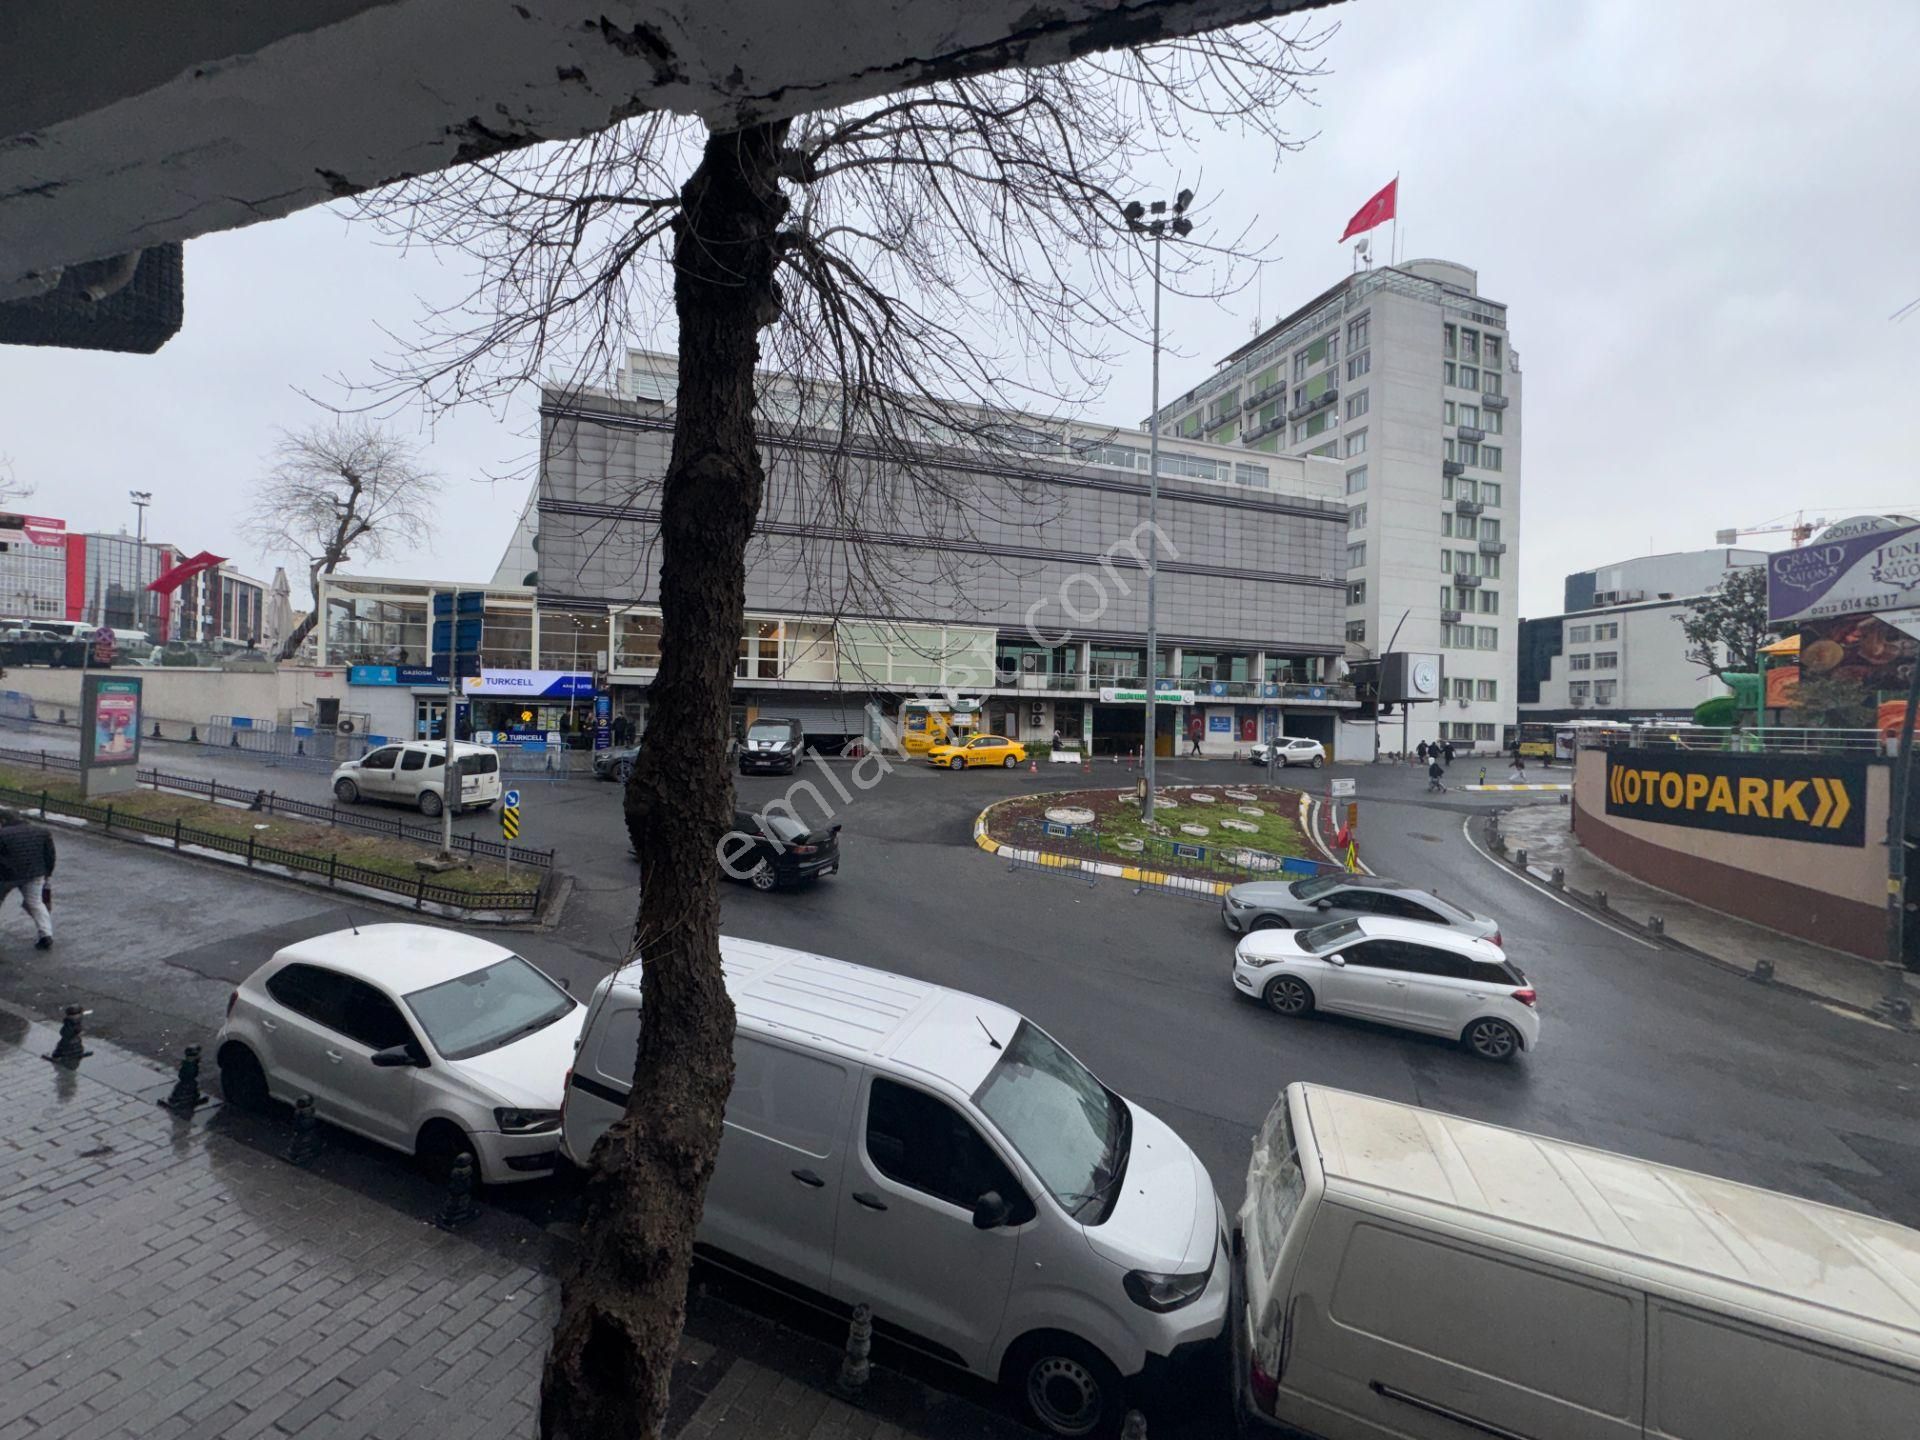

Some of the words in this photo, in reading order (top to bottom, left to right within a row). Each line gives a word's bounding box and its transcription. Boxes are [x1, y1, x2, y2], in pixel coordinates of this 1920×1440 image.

[1773, 545, 1845, 574] GRAND
[1811, 604, 1838, 615] 0212
[1840, 597, 1862, 612] 614
[1864, 595, 1880, 608] 43
[1883, 593, 1899, 606] 17
[485, 677, 534, 687] TURKCELL
[1623, 768, 1811, 822] OTOPARK
